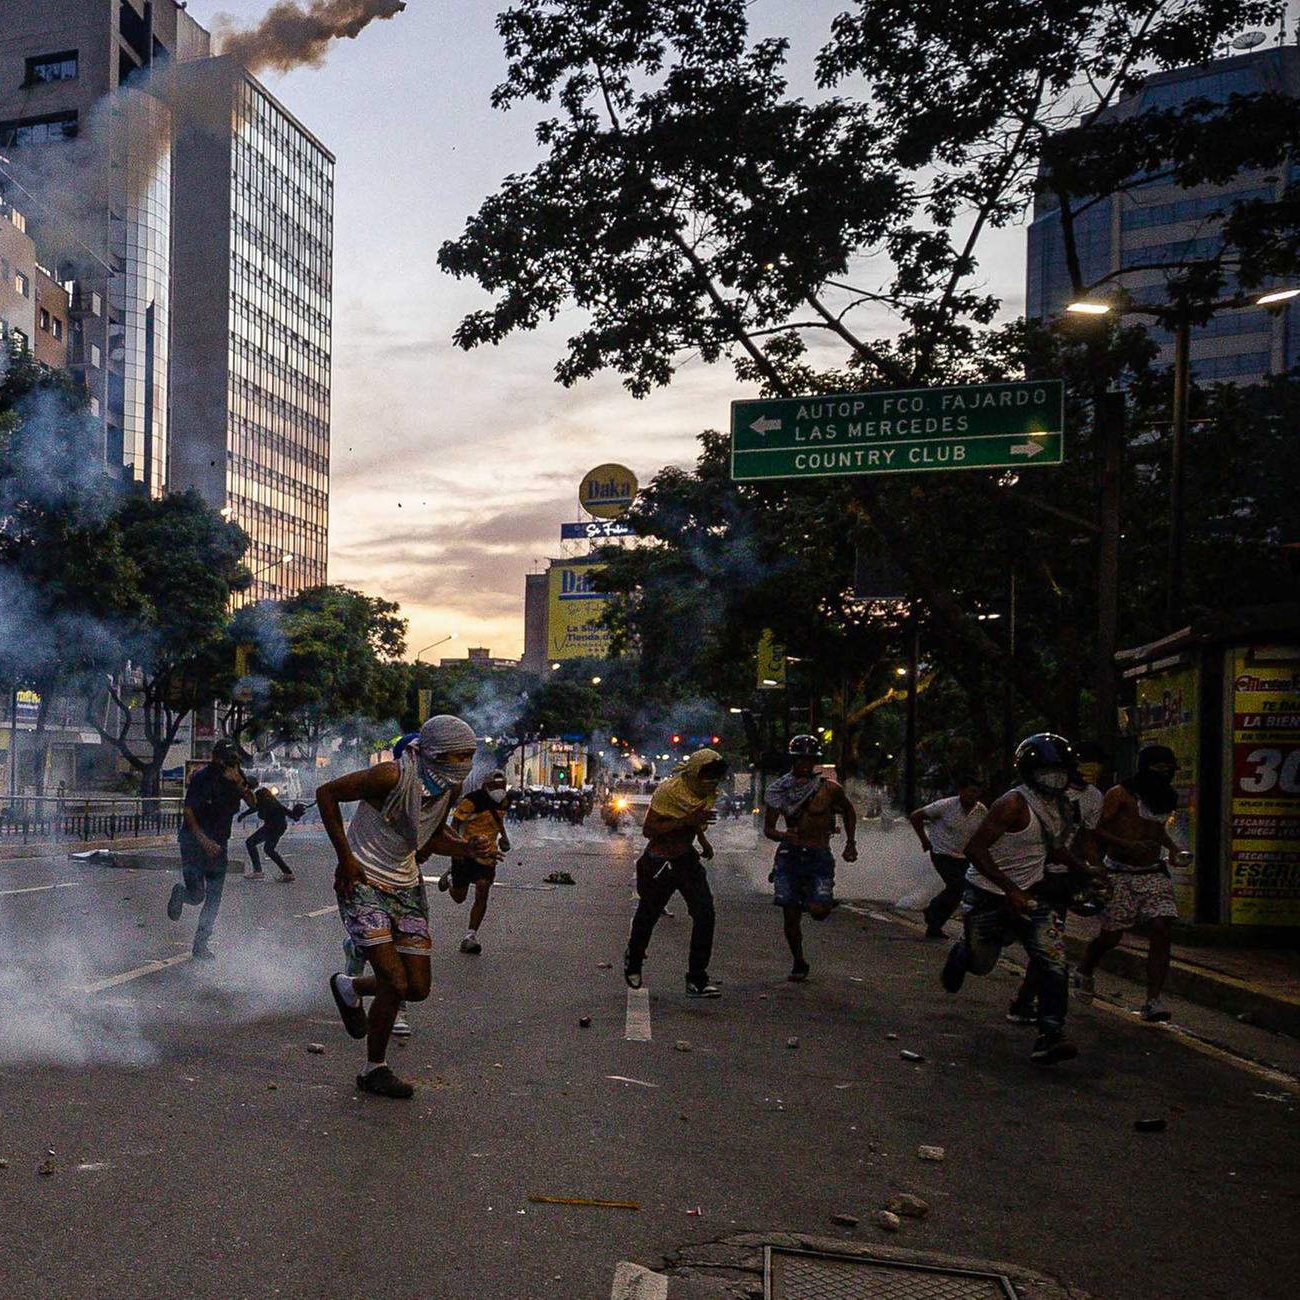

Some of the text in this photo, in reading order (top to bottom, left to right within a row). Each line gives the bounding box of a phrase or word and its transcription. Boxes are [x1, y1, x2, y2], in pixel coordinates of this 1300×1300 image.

[795, 388, 1047, 422] AUTOP. FCO. FAJARDO
[794, 415, 970, 443] LAS MERCEDES
[794, 445, 966, 470] COUNTRY CLUB
[587, 478, 631, 499] Daka
[567, 633, 600, 641] Tienda
[1243, 715, 1261, 727] LA
